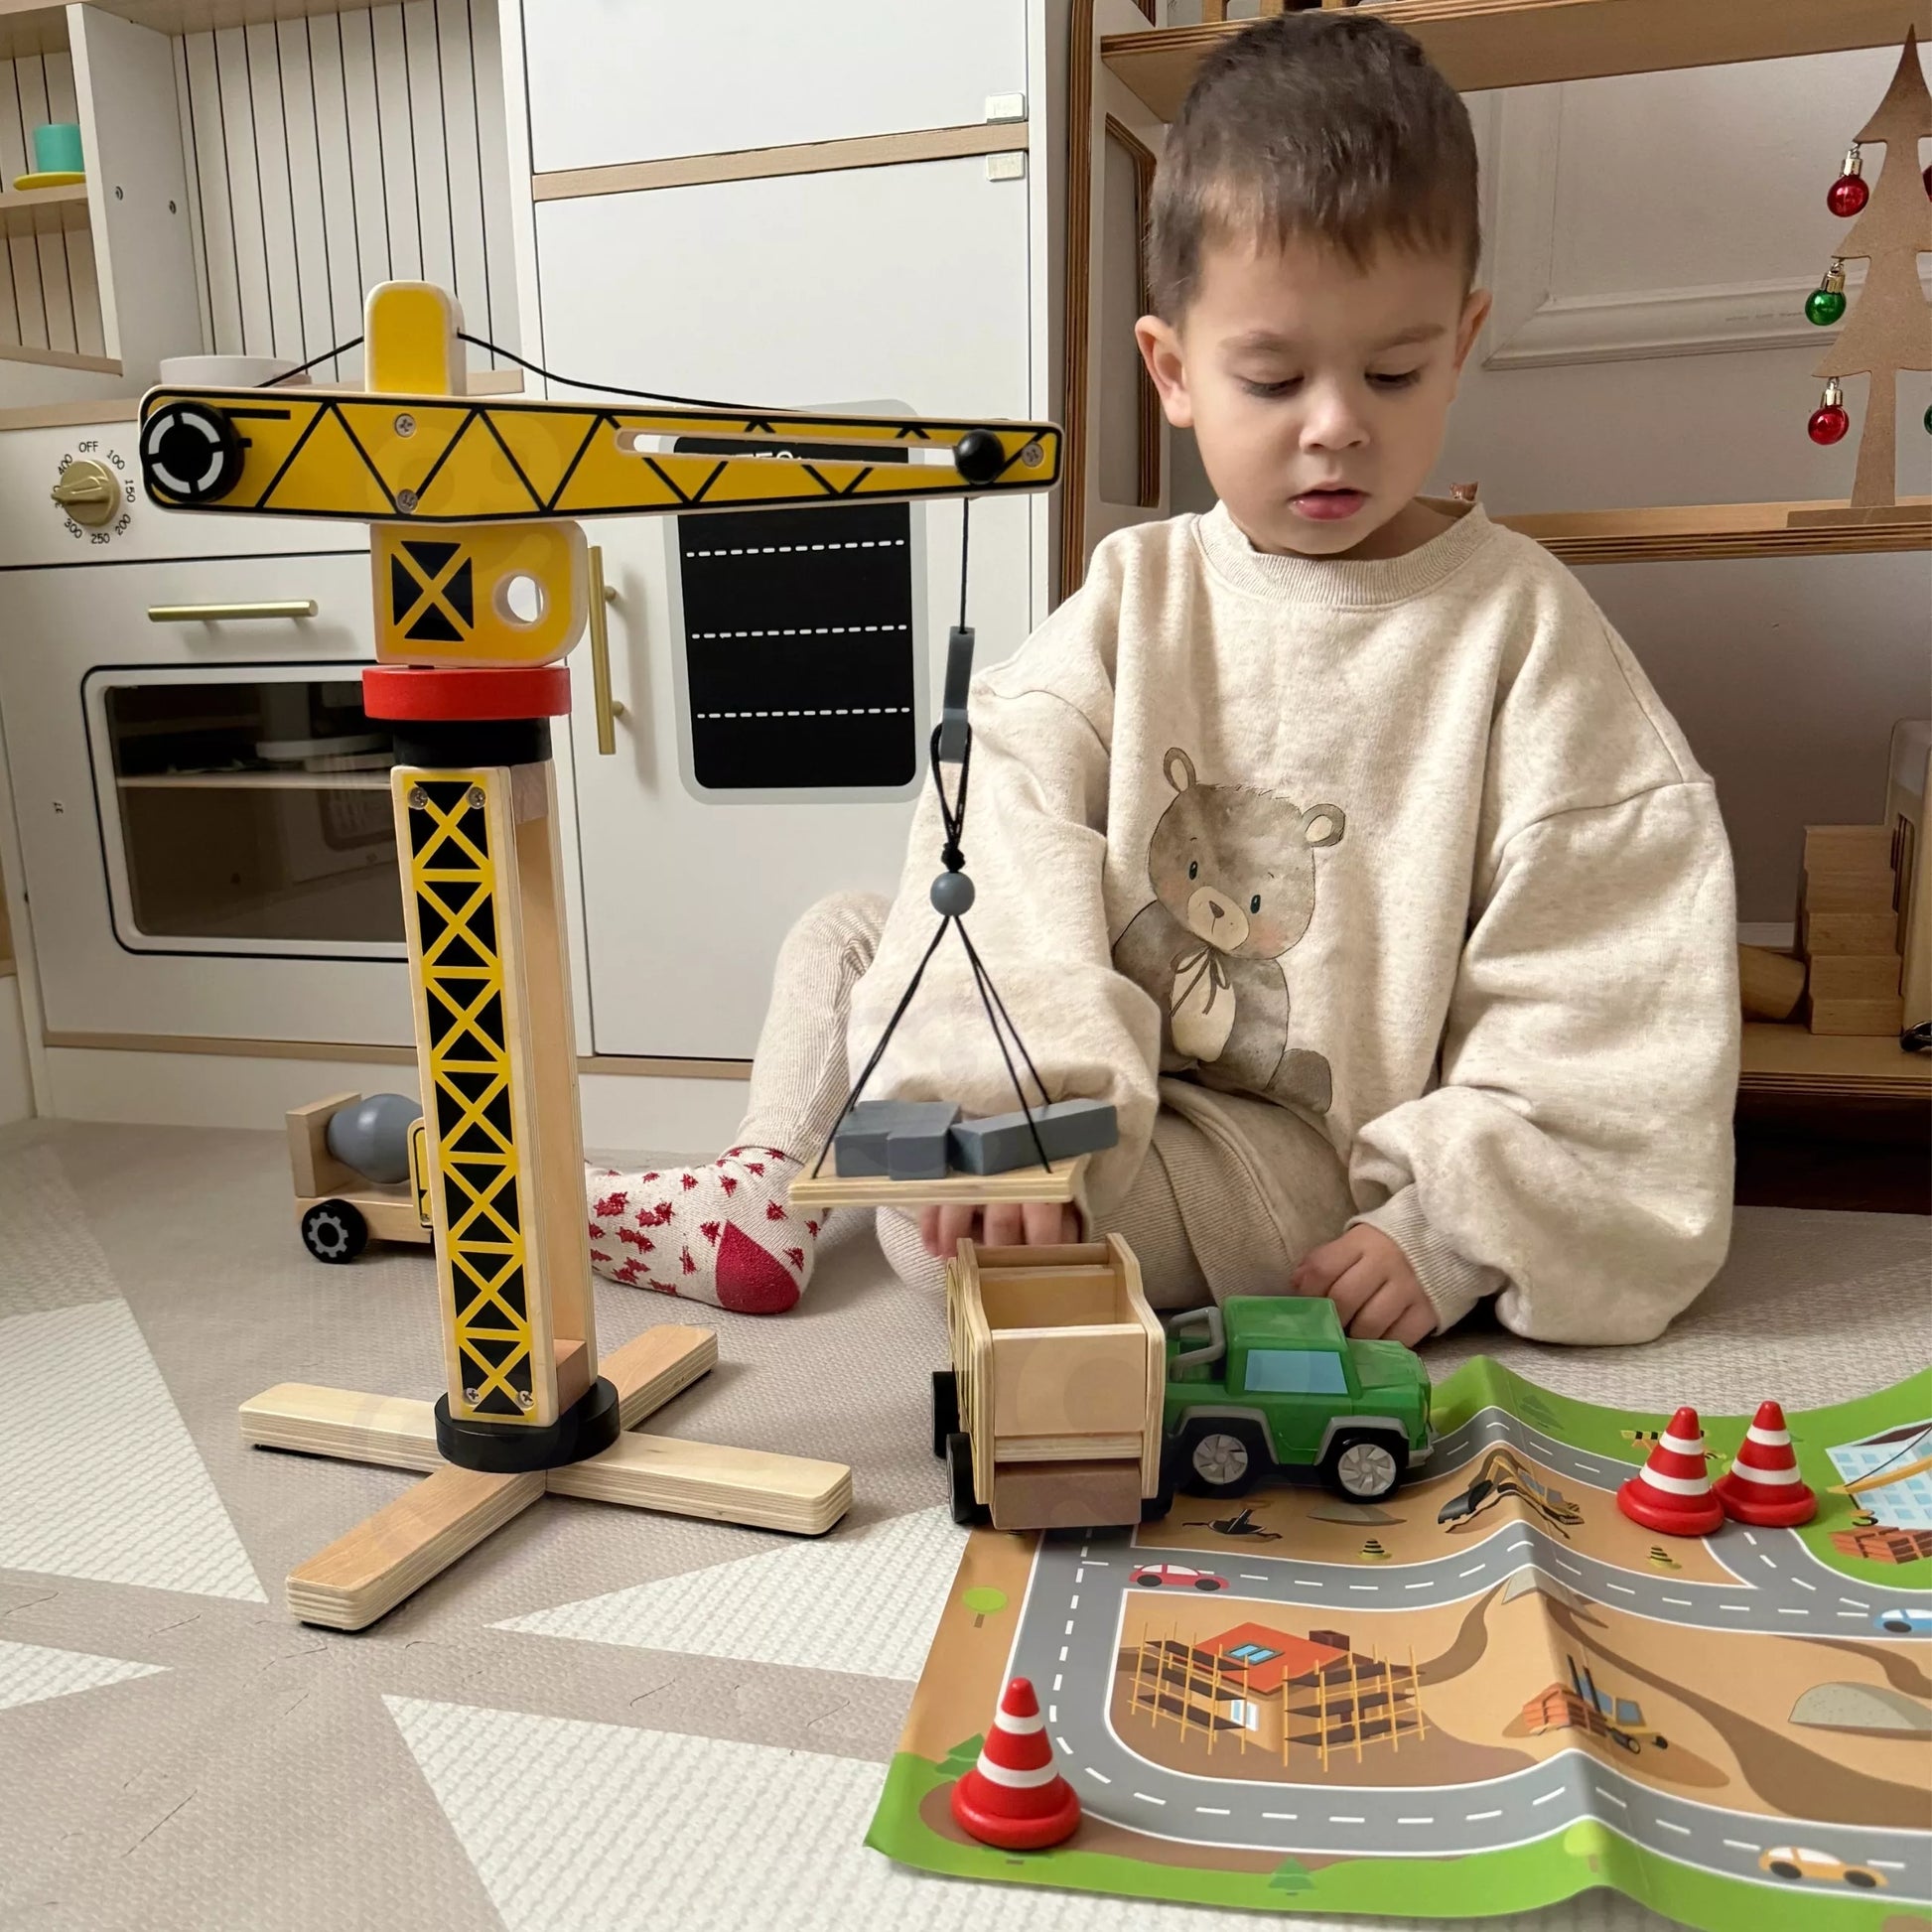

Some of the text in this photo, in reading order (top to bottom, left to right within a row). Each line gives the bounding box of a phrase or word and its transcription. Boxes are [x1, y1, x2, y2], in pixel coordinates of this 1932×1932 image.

[78, 441, 99, 453] OFF
[58, 454, 72, 475] 400
[106, 450, 125, 470] 100
[125, 480, 136, 502] 150
[64, 518, 82, 538] 300
[114, 514, 131, 535] 200
[91, 533, 110, 544] 250
